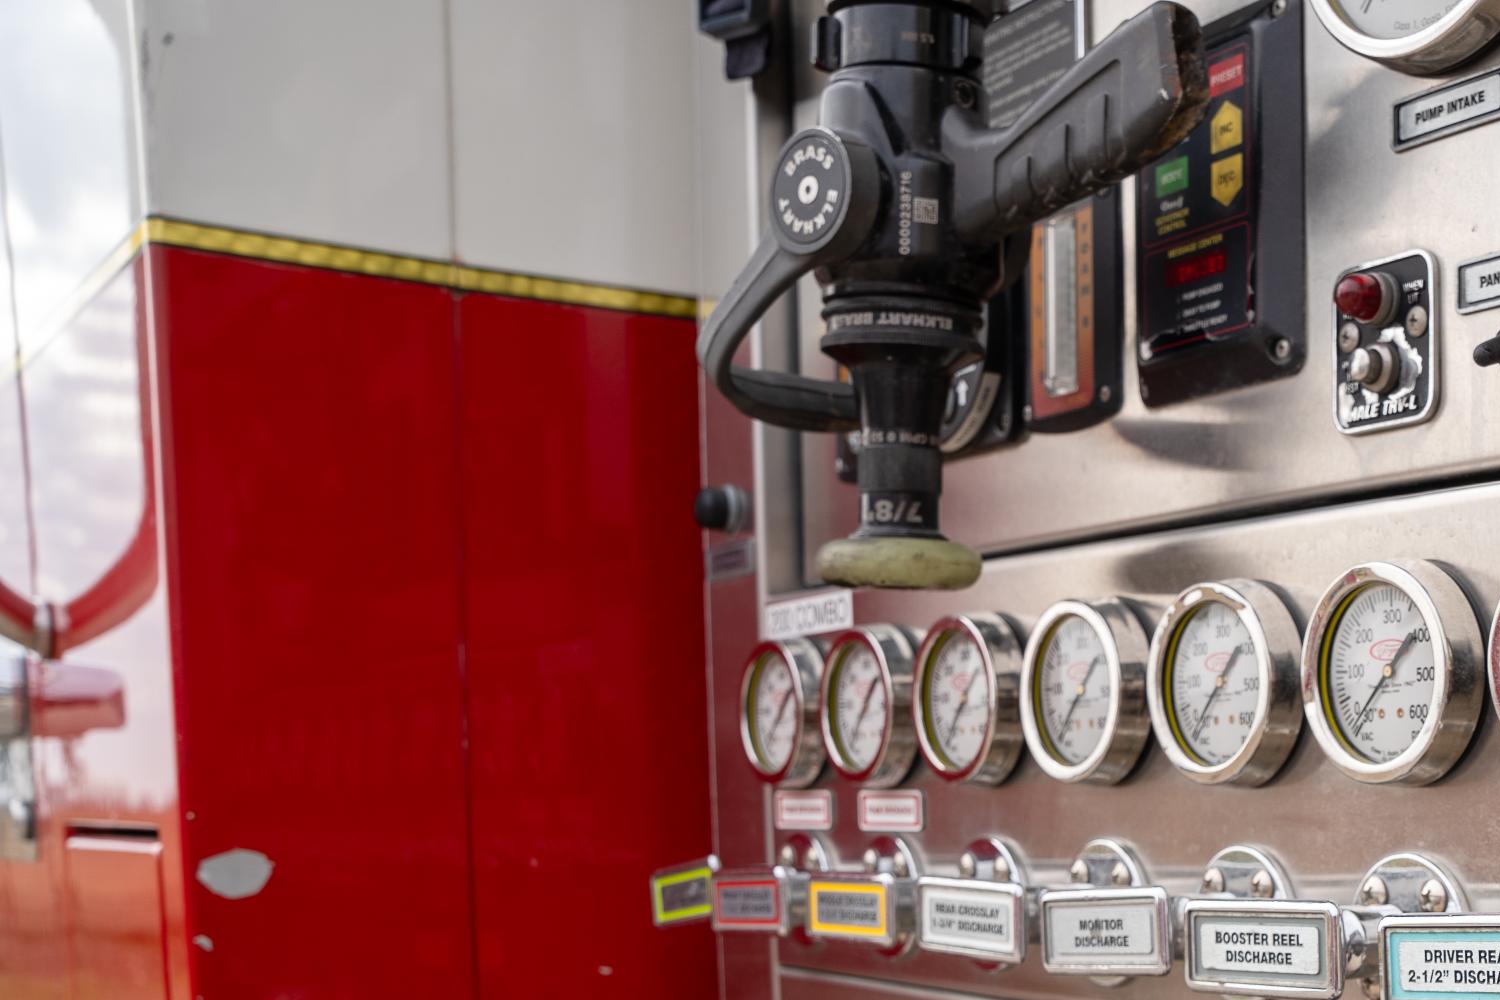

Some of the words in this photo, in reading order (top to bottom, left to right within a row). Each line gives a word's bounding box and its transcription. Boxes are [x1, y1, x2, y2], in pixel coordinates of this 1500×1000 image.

[1415, 104, 1444, 125] PUMP
[1447, 90, 1485, 114] INTAKE
[785, 146, 834, 176] BRASS
[779, 189, 838, 235] ELKHART
[877, 311, 953, 330] ELKHART
[1383, 609, 1401, 624] 300
[1355, 628, 1373, 643] 200
[1413, 627, 1430, 642] 400
[1348, 664, 1364, 679] 100
[1416, 666, 1435, 682] 500
[1244, 679, 1259, 691] 500
[1409, 704, 1428, 719] 600
[1079, 919, 1123, 931] MONITOR
[1075, 936, 1129, 947] DISCHARGE
[1215, 931, 1269, 946] BOOSTER
[1272, 933, 1303, 947] REEL
[1226, 951, 1292, 966] DISCHARGE
[1424, 950, 1474, 964] DRIVER
[1408, 969, 1449, 984] 2-1/2"
